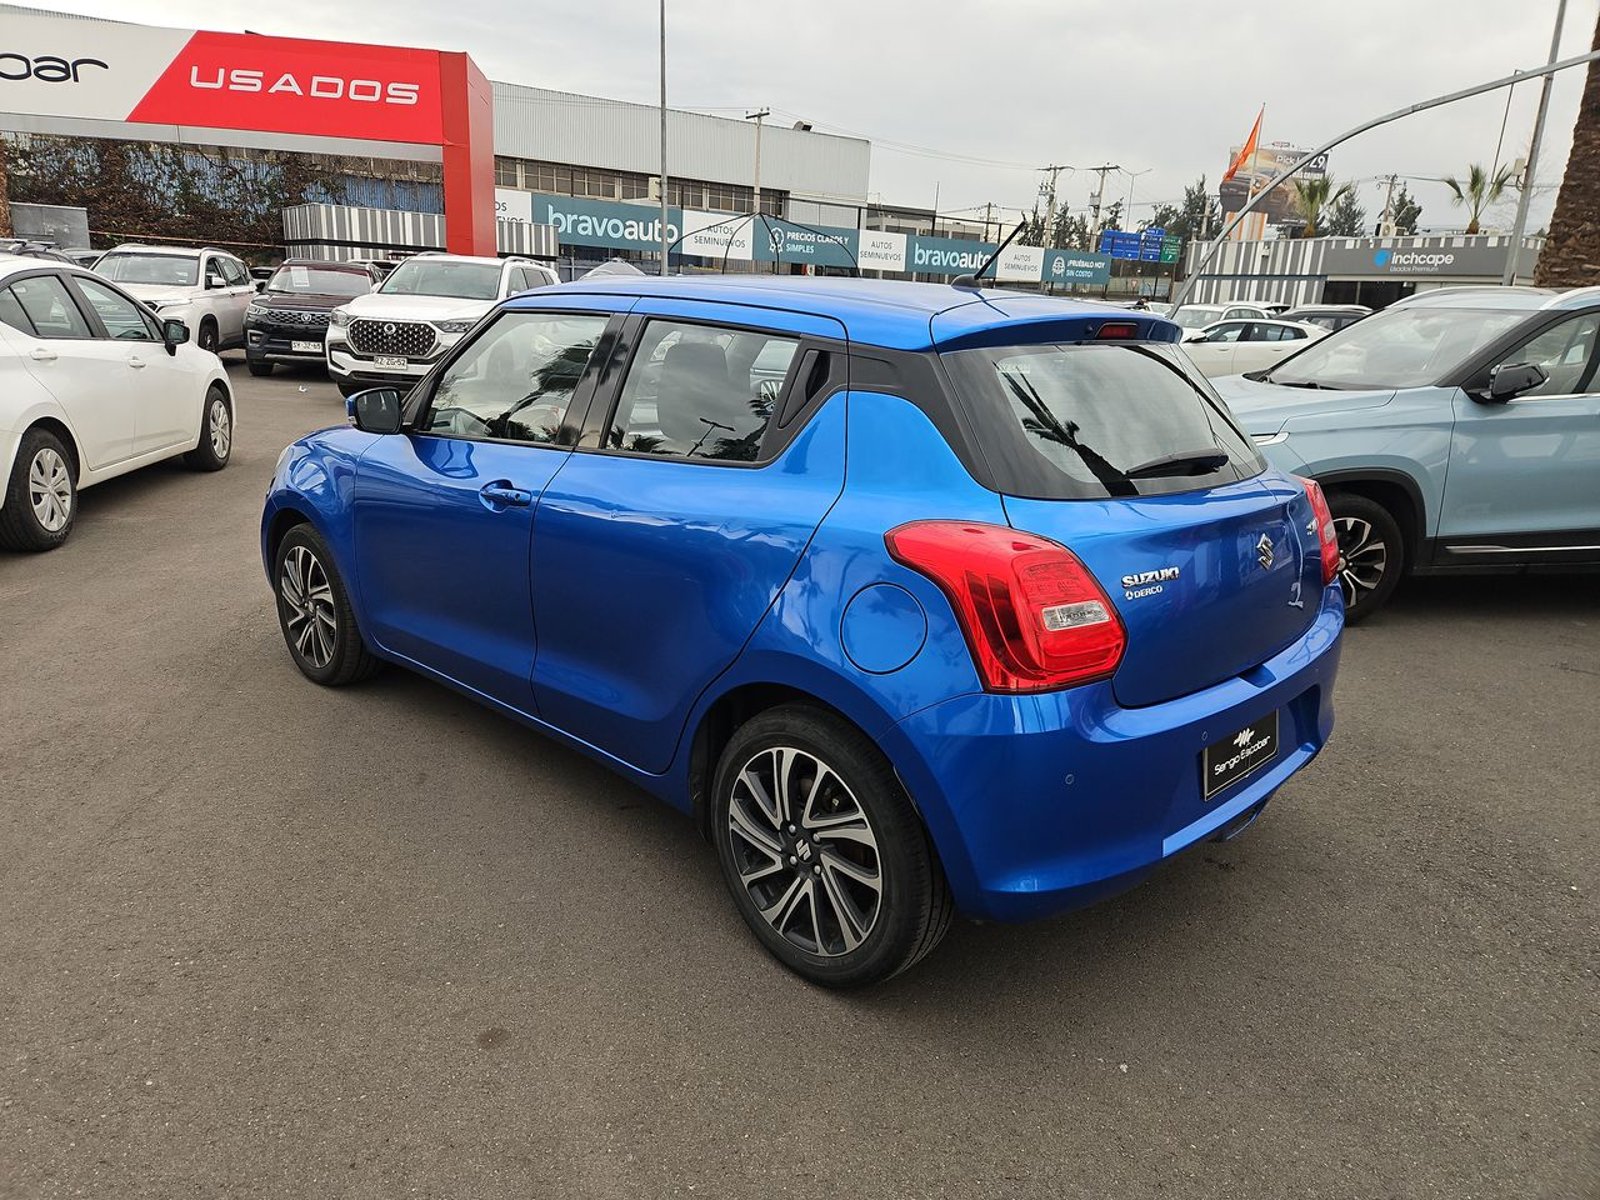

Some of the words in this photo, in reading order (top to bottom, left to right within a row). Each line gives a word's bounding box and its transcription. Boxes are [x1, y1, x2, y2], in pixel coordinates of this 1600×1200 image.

[190, 66, 420, 105] USADOS
[549, 204, 679, 243] bravoauto
[707, 226, 733, 235] AUTOS
[693, 235, 746, 249] SEMINUEVOS
[786, 231, 816, 243] PRECIOS
[817, 233, 843, 245] CLAROS
[844, 237, 850, 246] Y
[870, 240, 893, 250] AUTOS
[785, 243, 815, 254] SIMPLES
[860, 250, 902, 262] SEMINUEVOS
[914, 243, 992, 270] bravoauto
[1391, 251, 1455, 267] inchcape
[1121, 567, 1179, 588] SUZUKI
[1134, 585, 1163, 599] DERCO
[1240, 735, 1271, 760] Escobar
